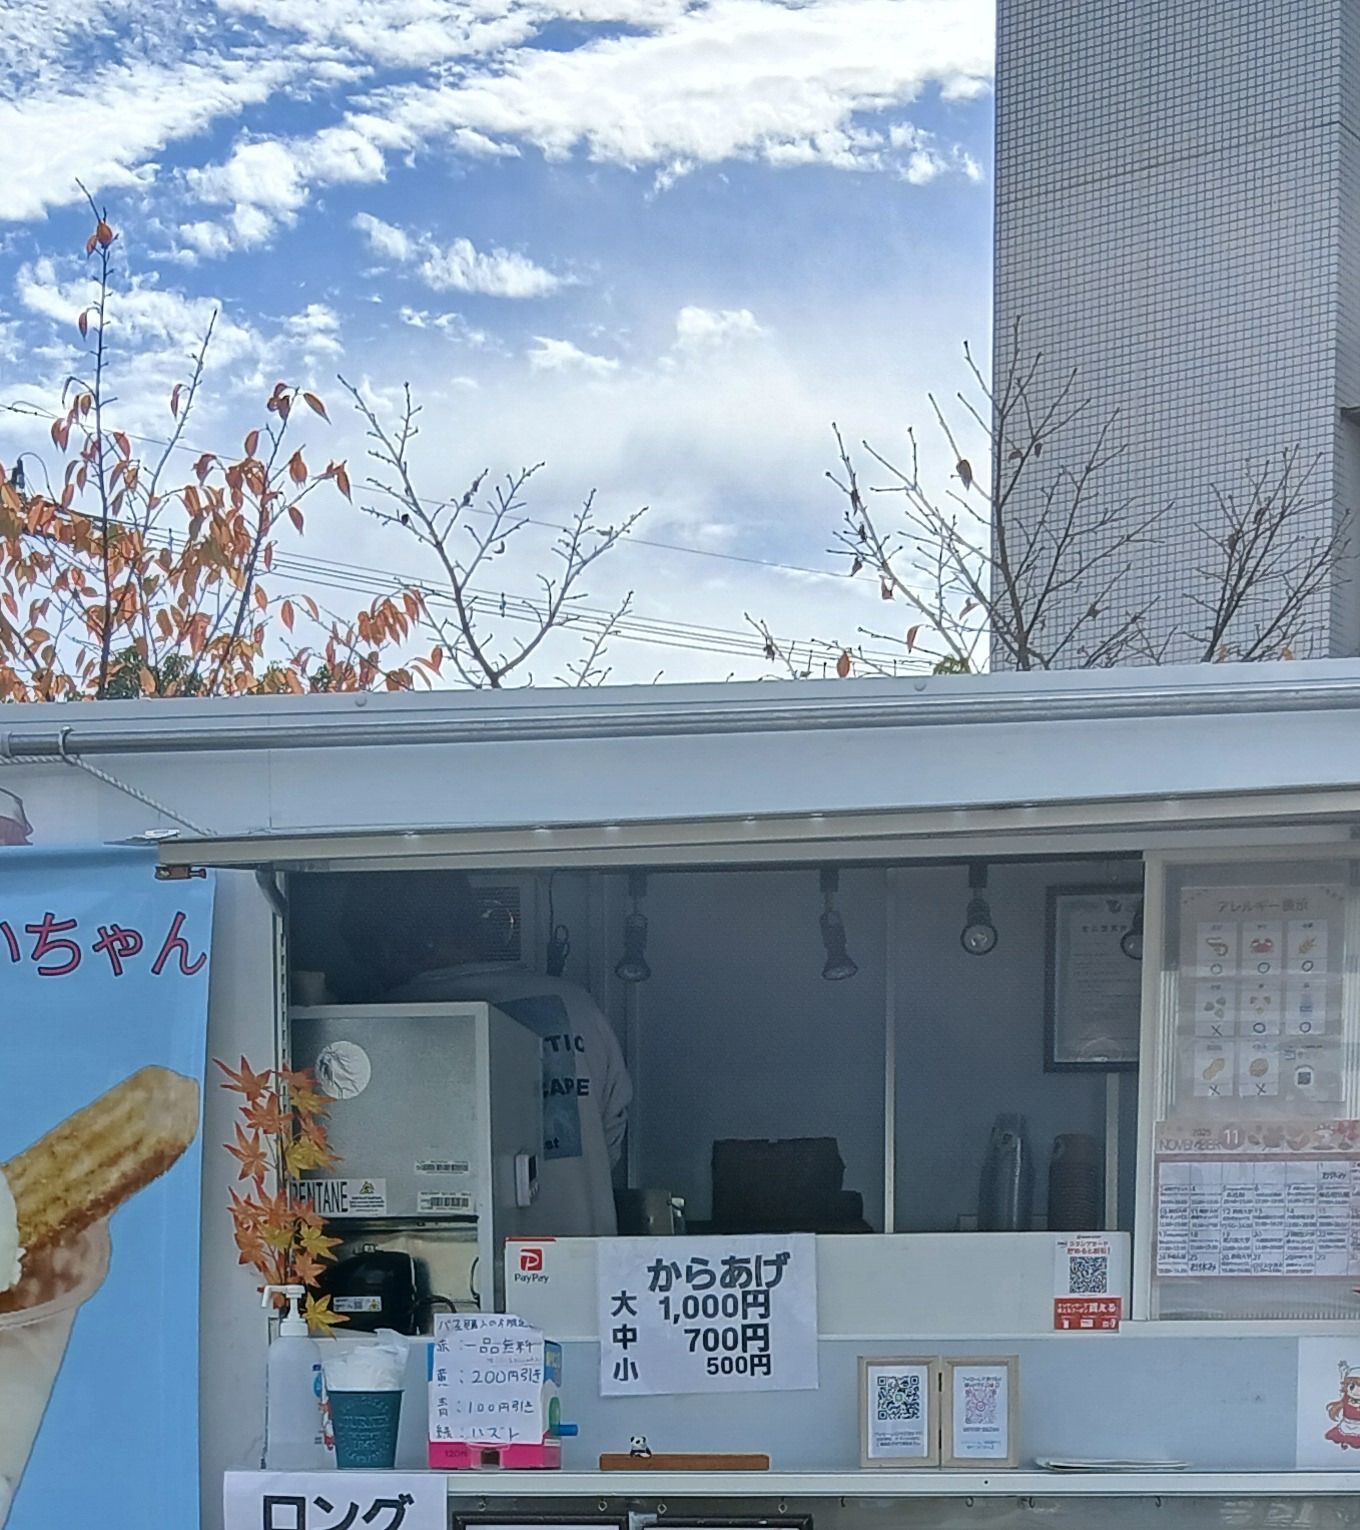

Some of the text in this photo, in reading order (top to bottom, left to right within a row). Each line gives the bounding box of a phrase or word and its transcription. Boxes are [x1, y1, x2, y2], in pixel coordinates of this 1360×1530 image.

[514, 1273, 549, 1284] PayPay
[648, 1252, 791, 1293] からあげ
[611, 1290, 770, 1324] 大 1,000円
[612, 1324, 770, 1354] 中 700円
[613, 1353, 771, 1382] 小 500円
